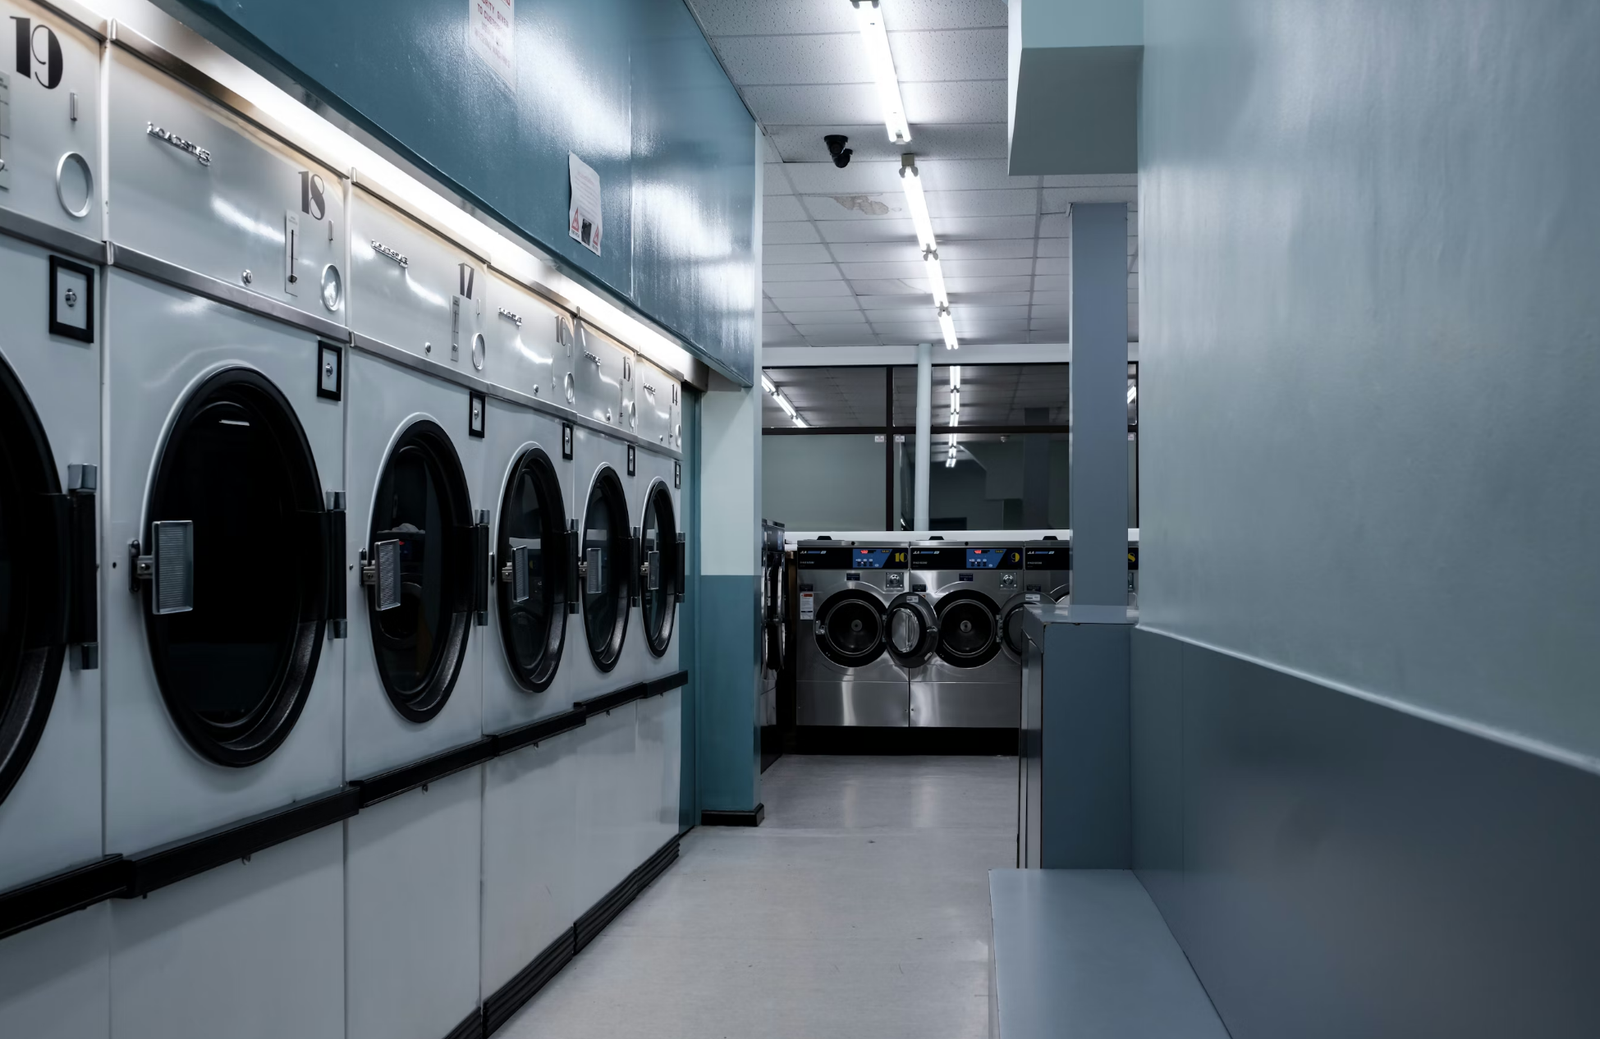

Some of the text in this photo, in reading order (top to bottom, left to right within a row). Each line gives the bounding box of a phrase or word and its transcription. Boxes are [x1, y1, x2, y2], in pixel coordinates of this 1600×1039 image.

[9, 15, 64, 90] 19
[298, 171, 326, 221] 18
[458, 262, 475, 300] 17
[554, 315, 567, 347] 16
[622, 356, 632, 382] 15
[671, 383, 679, 406] 14
[894, 552, 909, 563] 10
[1010, 552, 1021, 563] 9
